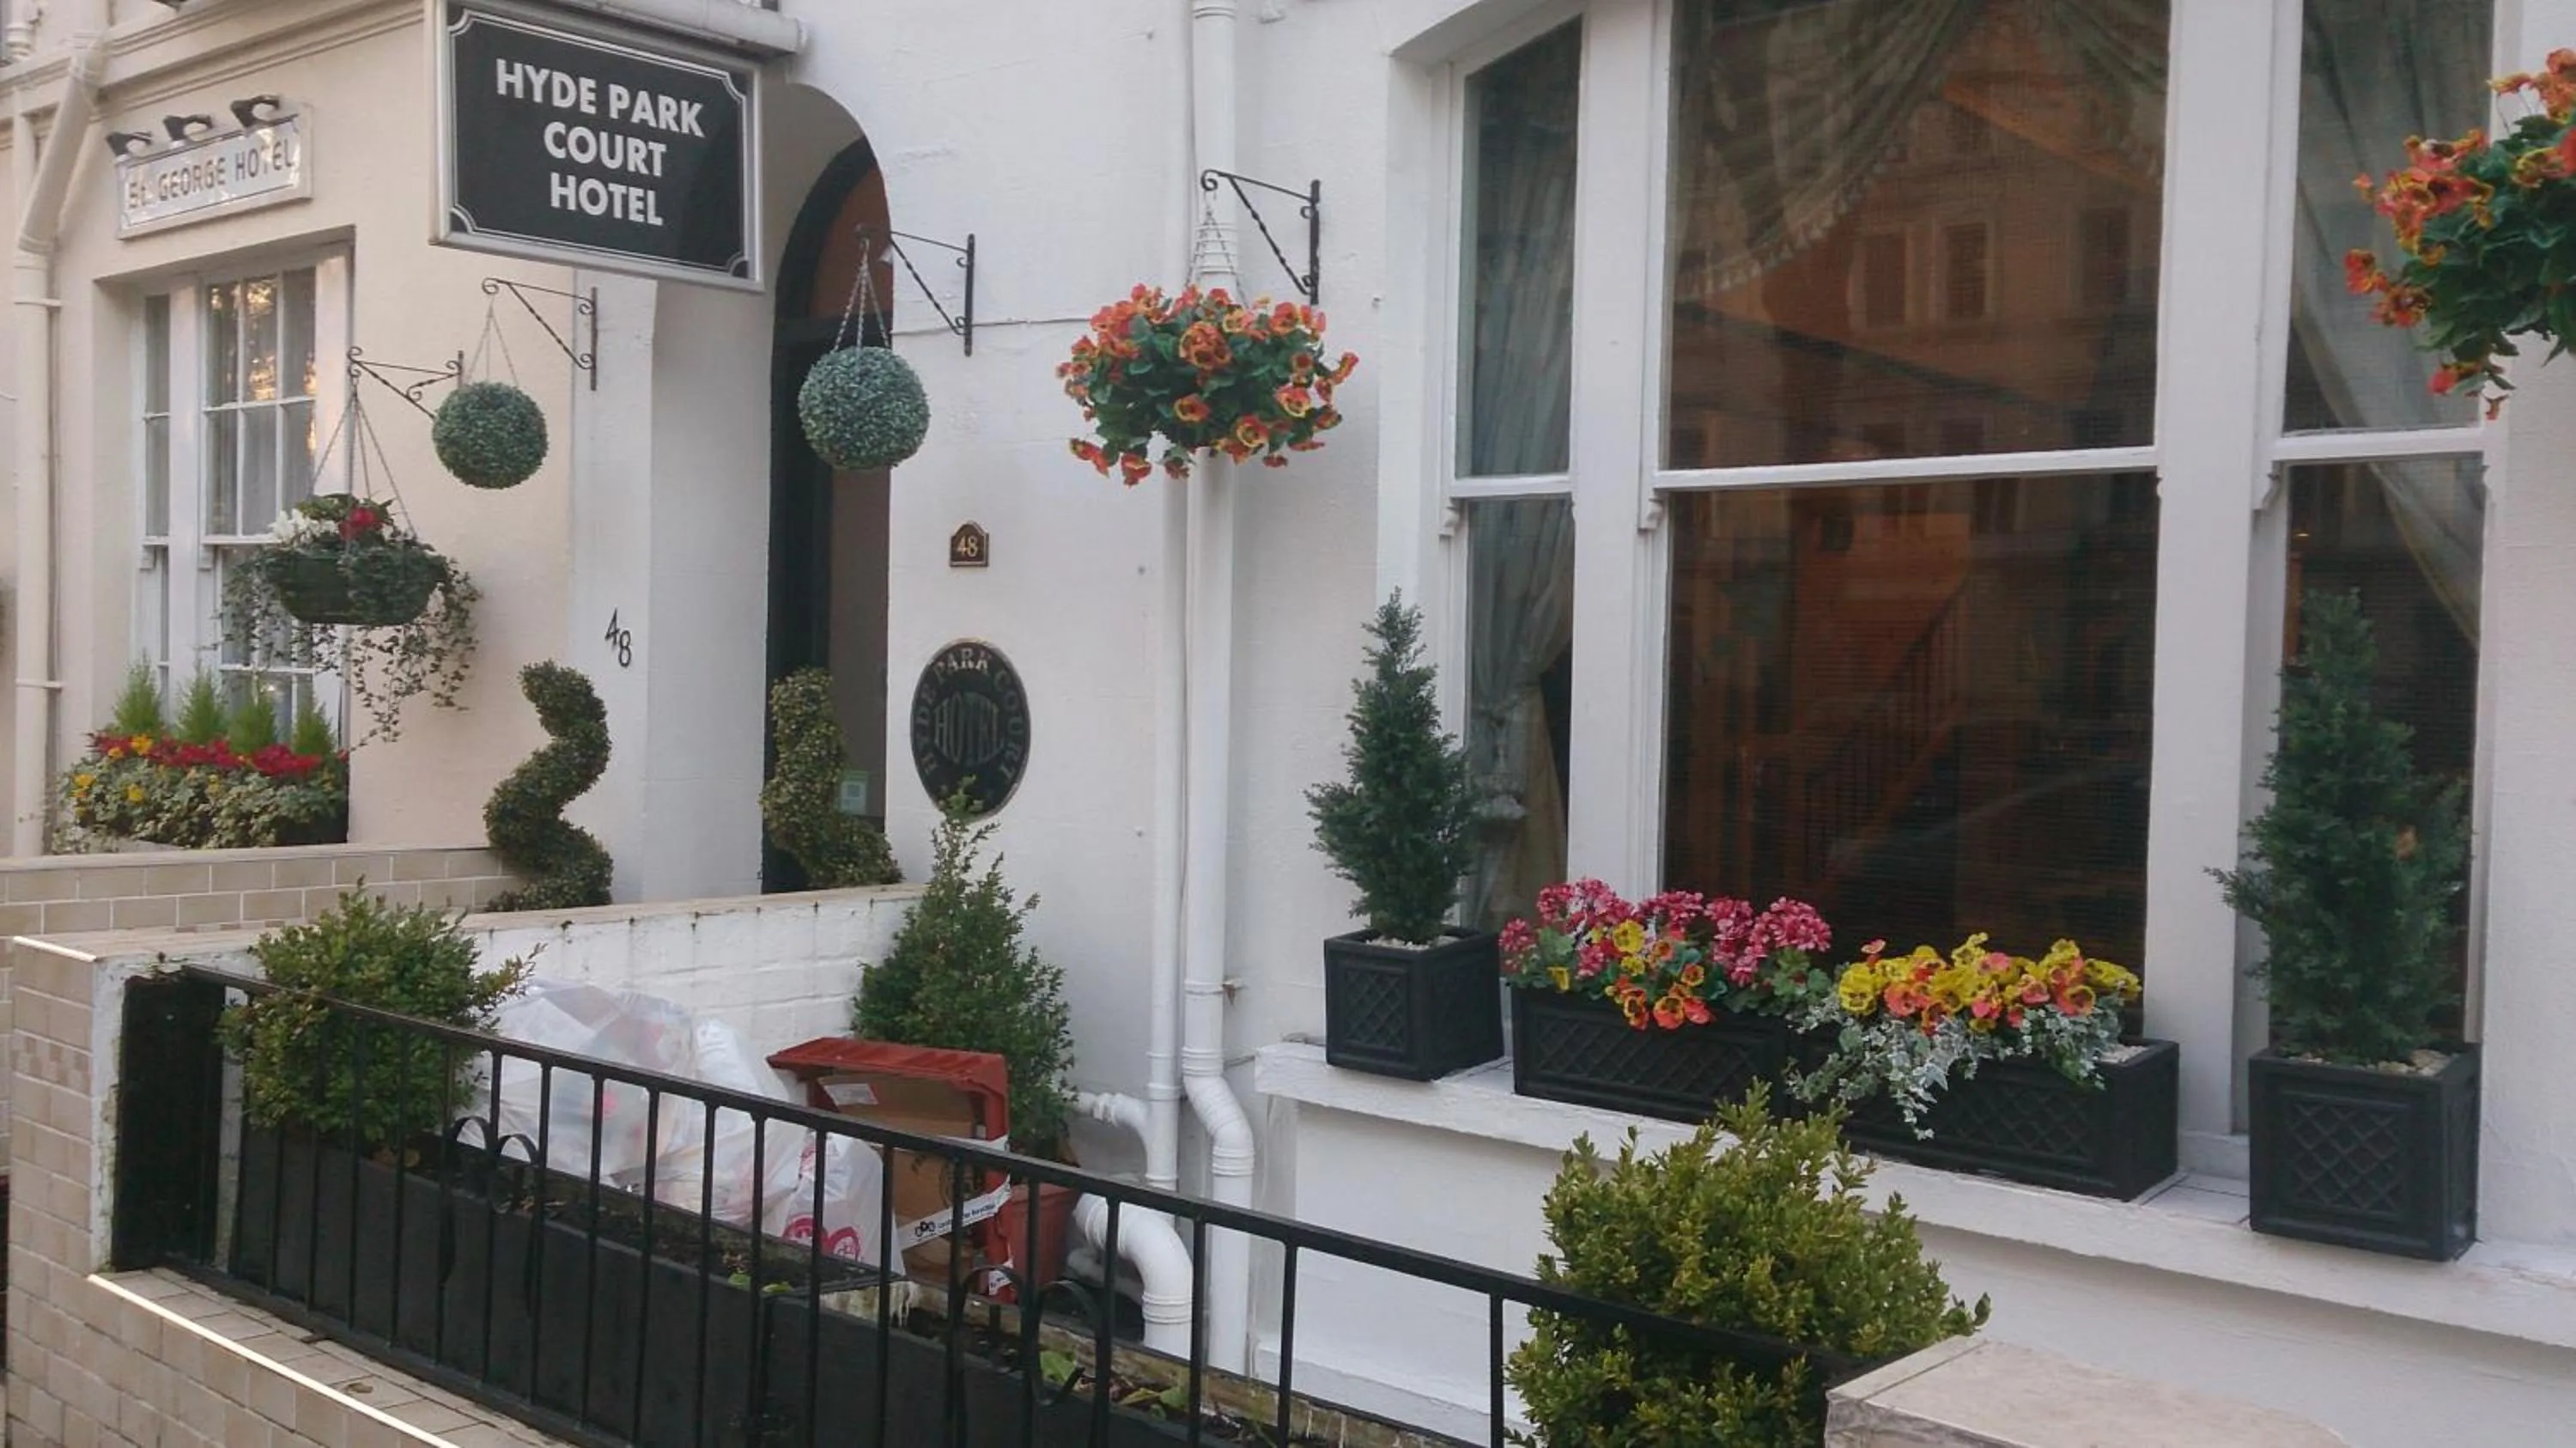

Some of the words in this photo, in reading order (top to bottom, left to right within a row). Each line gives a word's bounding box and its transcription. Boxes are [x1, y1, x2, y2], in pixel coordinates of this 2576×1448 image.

[495, 58, 598, 115] HYDE
[608, 83, 706, 138] PARK
[158, 157, 227, 202] GEORGE
[234, 138, 295, 182] HOTEL
[544, 120, 667, 178] COURT
[550, 172, 664, 226] HOTEL
[957, 534, 979, 557] 48
[605, 606, 632, 668] 48
